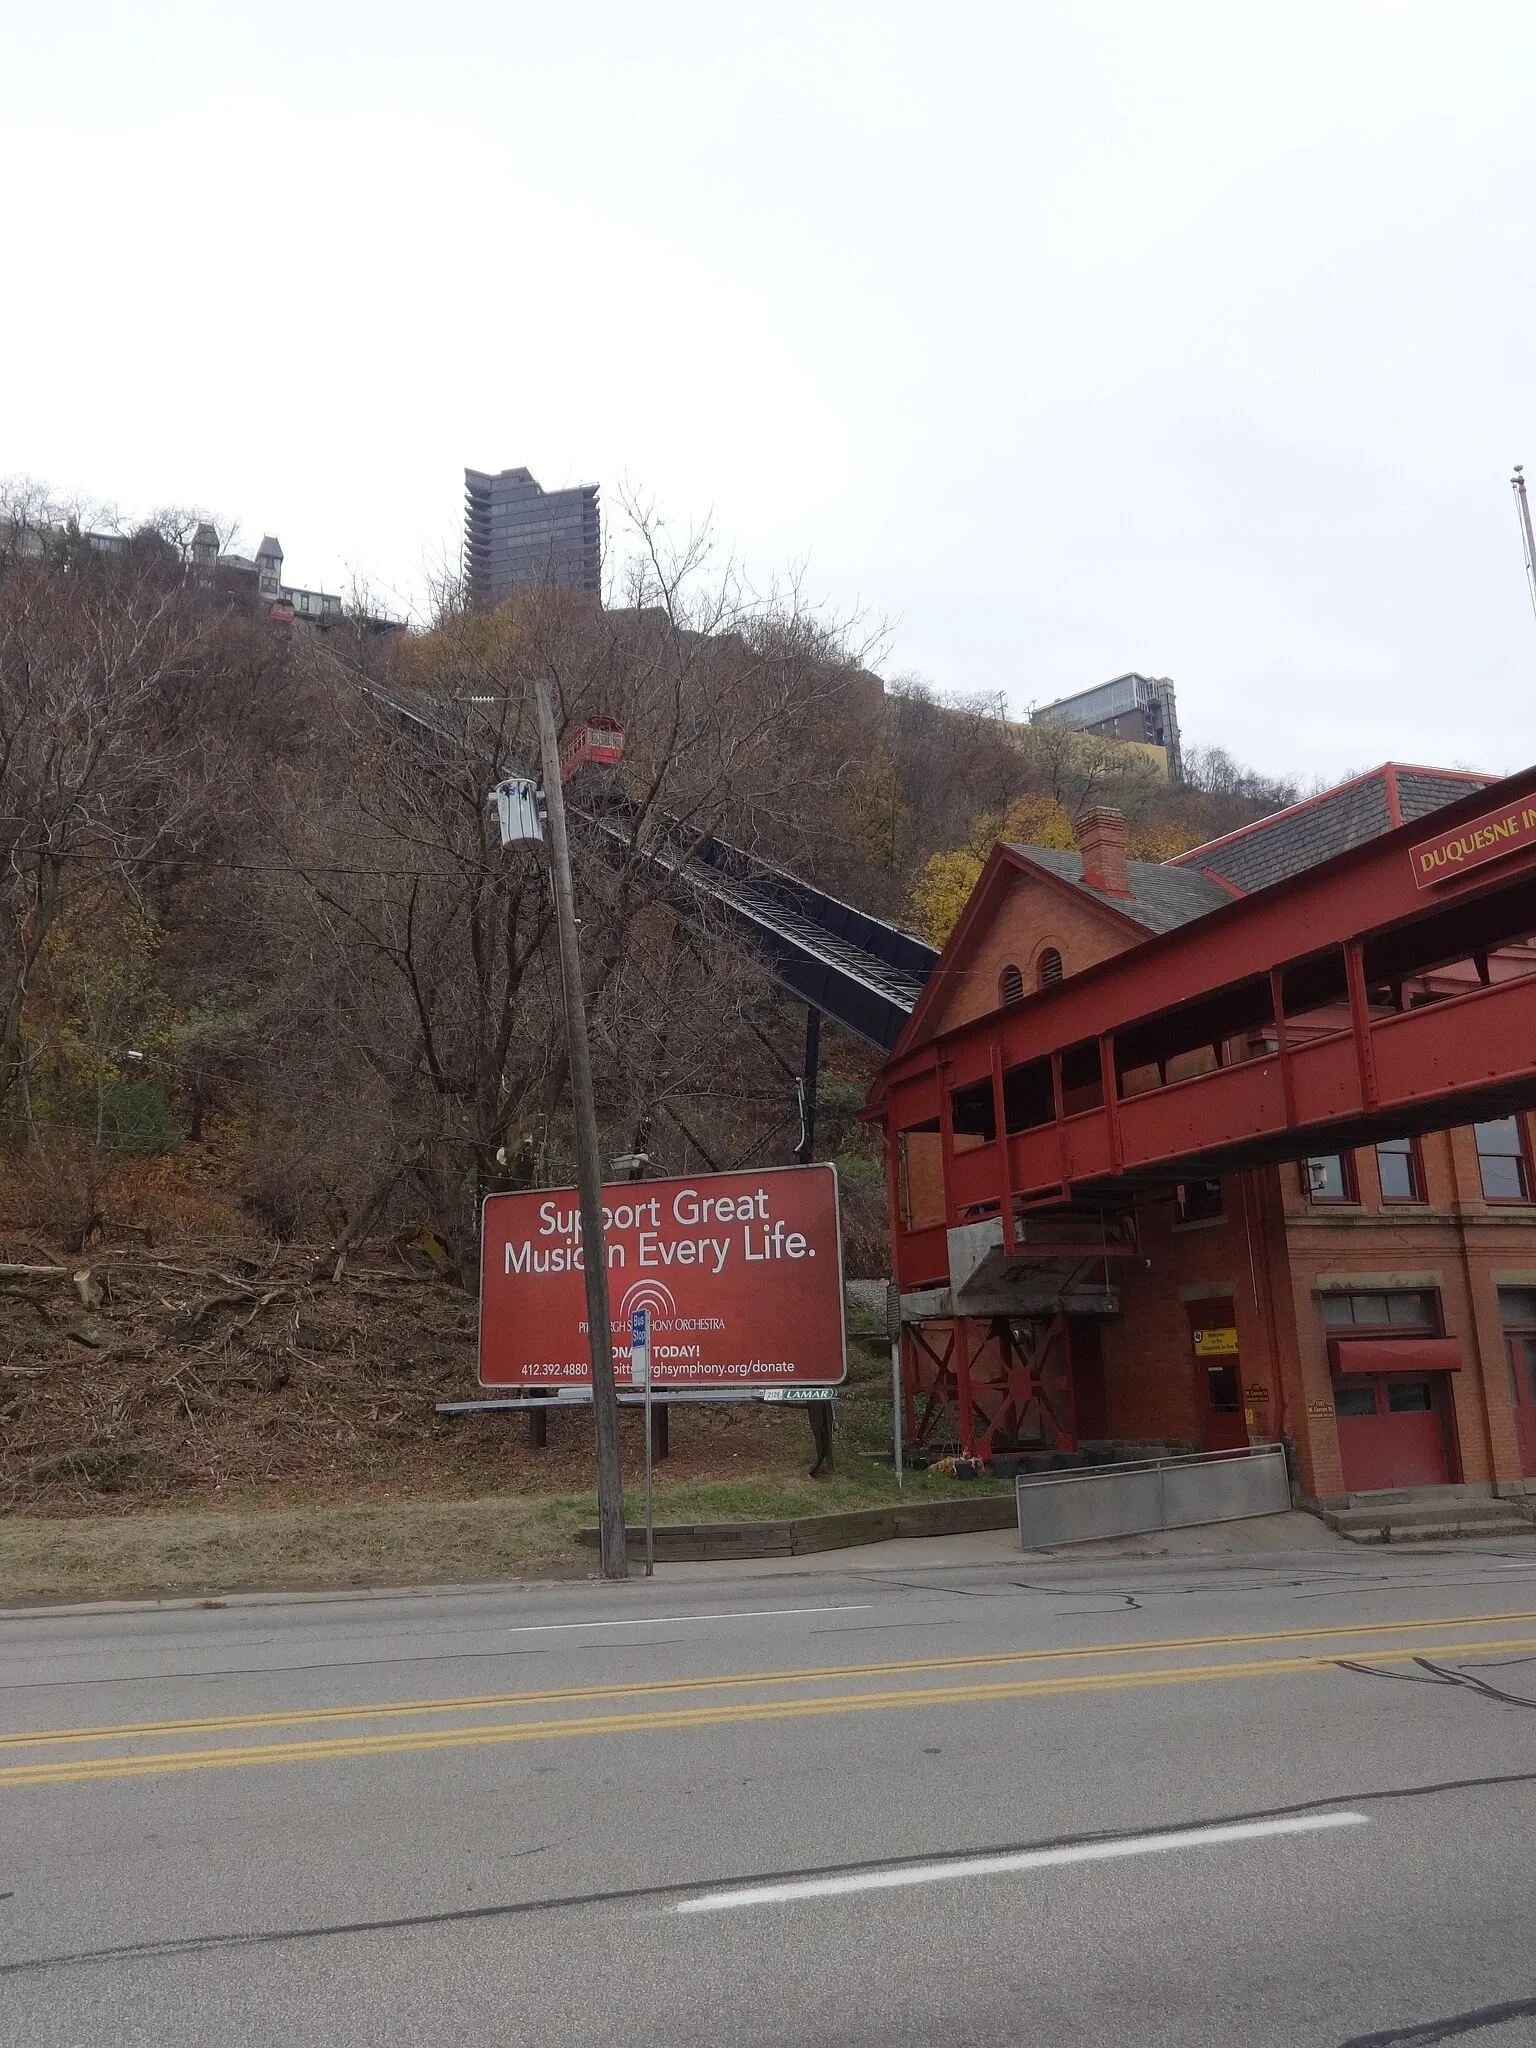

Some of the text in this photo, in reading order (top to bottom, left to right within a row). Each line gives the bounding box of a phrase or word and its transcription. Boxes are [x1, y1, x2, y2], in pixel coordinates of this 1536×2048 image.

[1420, 816, 1520, 872] DUQUESNE
[673, 1188, 770, 1225] Great
[504, 1237, 585, 1274] Music
[639, 1231, 731, 1274] Every
[744, 1220, 816, 1261] Life.
[633, 1314, 645, 1327] Bus
[675, 1318, 725, 1331] ORCHESTRA
[632, 1329, 646, 1343] Stop
[653, 1345, 700, 1358] TODAY!
[521, 1363, 588, 1376] 412.392.4880
[786, 1389, 829, 1399] LAMAR
